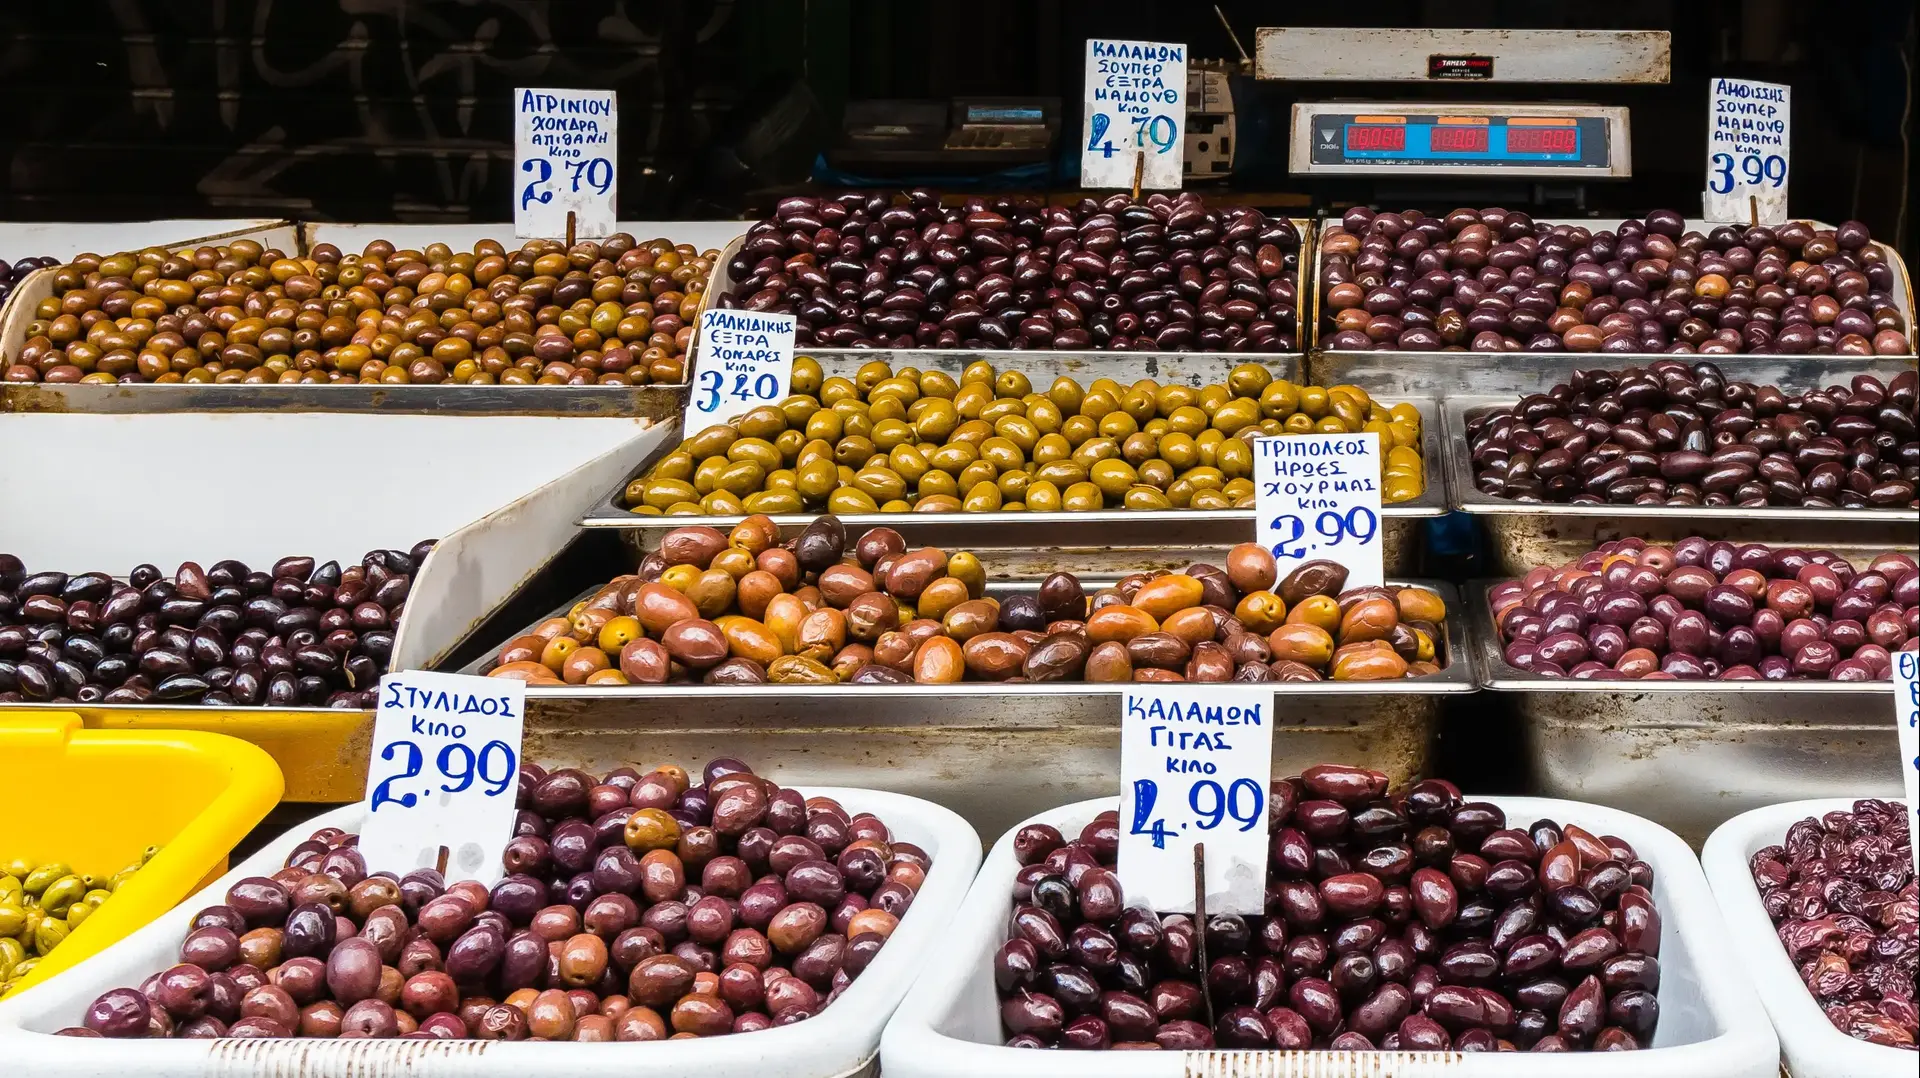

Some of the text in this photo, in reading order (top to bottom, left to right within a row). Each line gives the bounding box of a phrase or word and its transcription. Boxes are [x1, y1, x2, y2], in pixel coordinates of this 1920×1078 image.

[1093, 41, 1182, 62] ΚΑΛΑΜΩΝ
[1098, 59, 1162, 76] ΣΟΥΠΕΡ
[1106, 75, 1164, 89] ΕΞΤΡΑ
[1716, 78, 1785, 103] ΑΜΦΙΣΣΗΣ
[522, 89, 610, 116] ΑΓΡΙΝΙΟΥ
[1095, 88, 1177, 104] ΜΑΜΟΥΘ
[1716, 99, 1777, 118] ΣΟΥΠΕΡ
[532, 116, 598, 132] ΧΟΝΔΡΑ
[1718, 115, 1784, 133] ΜΑΜΟΥΘ
[532, 132, 607, 146] ΑΠΙΘΑΝΗ
[1714, 130, 1782, 146] ΑΠΙΘΑΝΗ
[1709, 152, 1787, 194] 3.99
[704, 311, 793, 334] ΧΑΛΚΙΔΙΚΗΣ
[711, 330, 769, 348] ΕΞΤΡΑ
[711, 346, 781, 362] ΧΟΝΔΡΕΣ
[1256, 439, 1369, 457] ΤΡΙΠΟΛΕΟΣ
[1275, 461, 1347, 478] ΗΡΩΕΣ
[1264, 479, 1376, 496] ΧΟΥΡΜΑΣ
[1270, 505, 1377, 560] 2.99
[385, 682, 515, 718] ΣΤΥΛΙΔΟΣ
[1129, 696, 1261, 726] ΚΑΛΑΜΩΝ
[1150, 726, 1232, 751] ΓΙΓΑΣ
[371, 740, 516, 812] 2.99
[1129, 778, 1264, 850] 4.99
